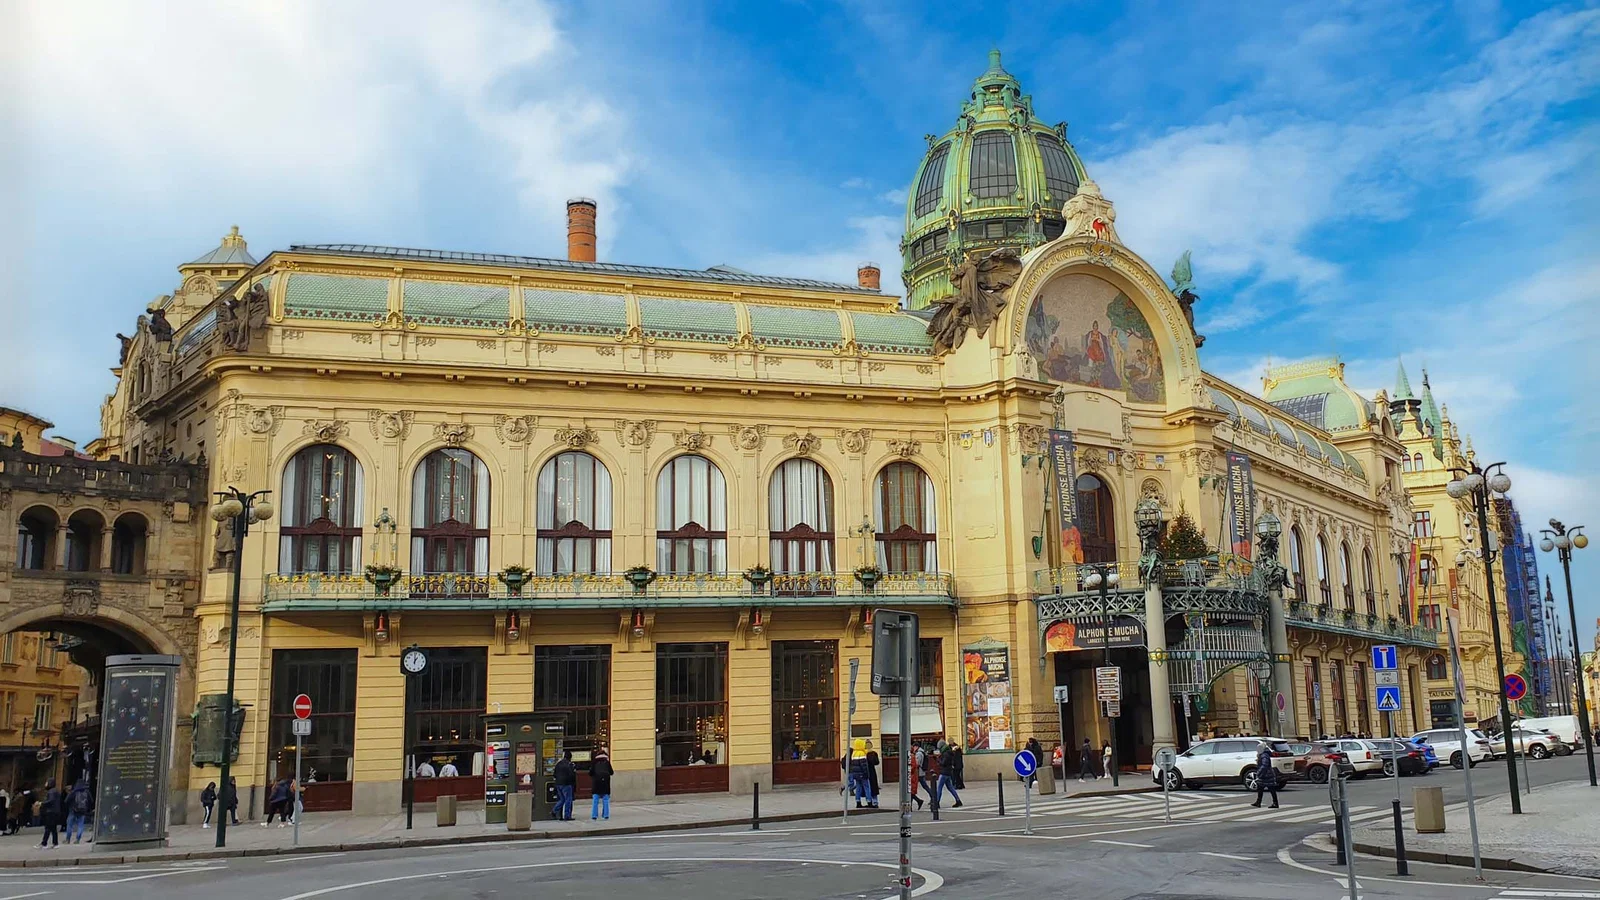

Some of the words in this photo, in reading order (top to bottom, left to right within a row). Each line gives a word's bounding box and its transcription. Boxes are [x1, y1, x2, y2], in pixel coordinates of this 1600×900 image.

[1055, 444, 1067, 476] MUCHA
[1067, 464, 1075, 495] EXHIBITION
[1231, 465, 1242, 494] MUCHA
[1060, 477, 1072, 523] ALPHONSE
[1234, 495, 1245, 537] ALPHONSE
[1078, 627, 1113, 638] ALPHONE
[1114, 625, 1140, 636] MUCHA
